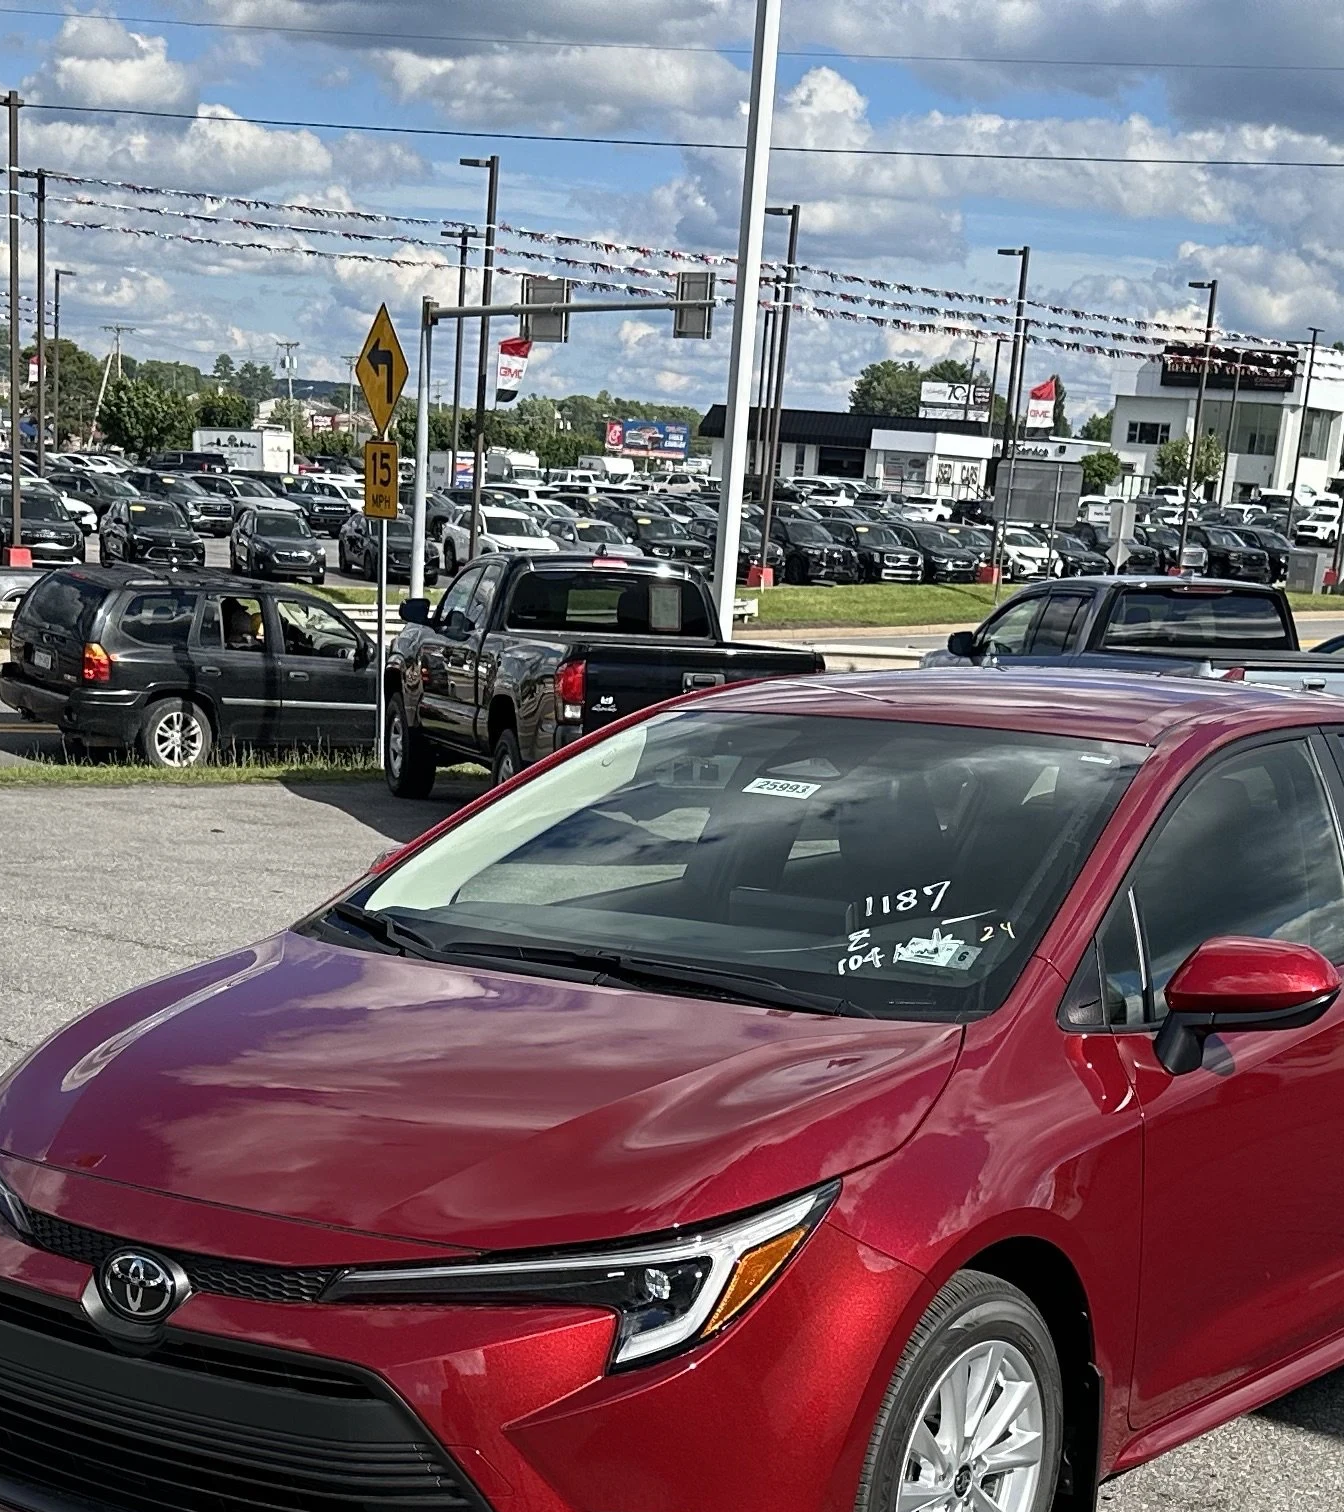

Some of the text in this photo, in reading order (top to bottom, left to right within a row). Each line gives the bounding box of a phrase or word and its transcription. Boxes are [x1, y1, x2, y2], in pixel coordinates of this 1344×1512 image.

[500, 367, 523, 380] GMC
[371, 451, 391, 488] 15
[371, 494, 391, 510] MPH
[753, 780, 811, 794] 25993
[865, 880, 952, 917] 1187
